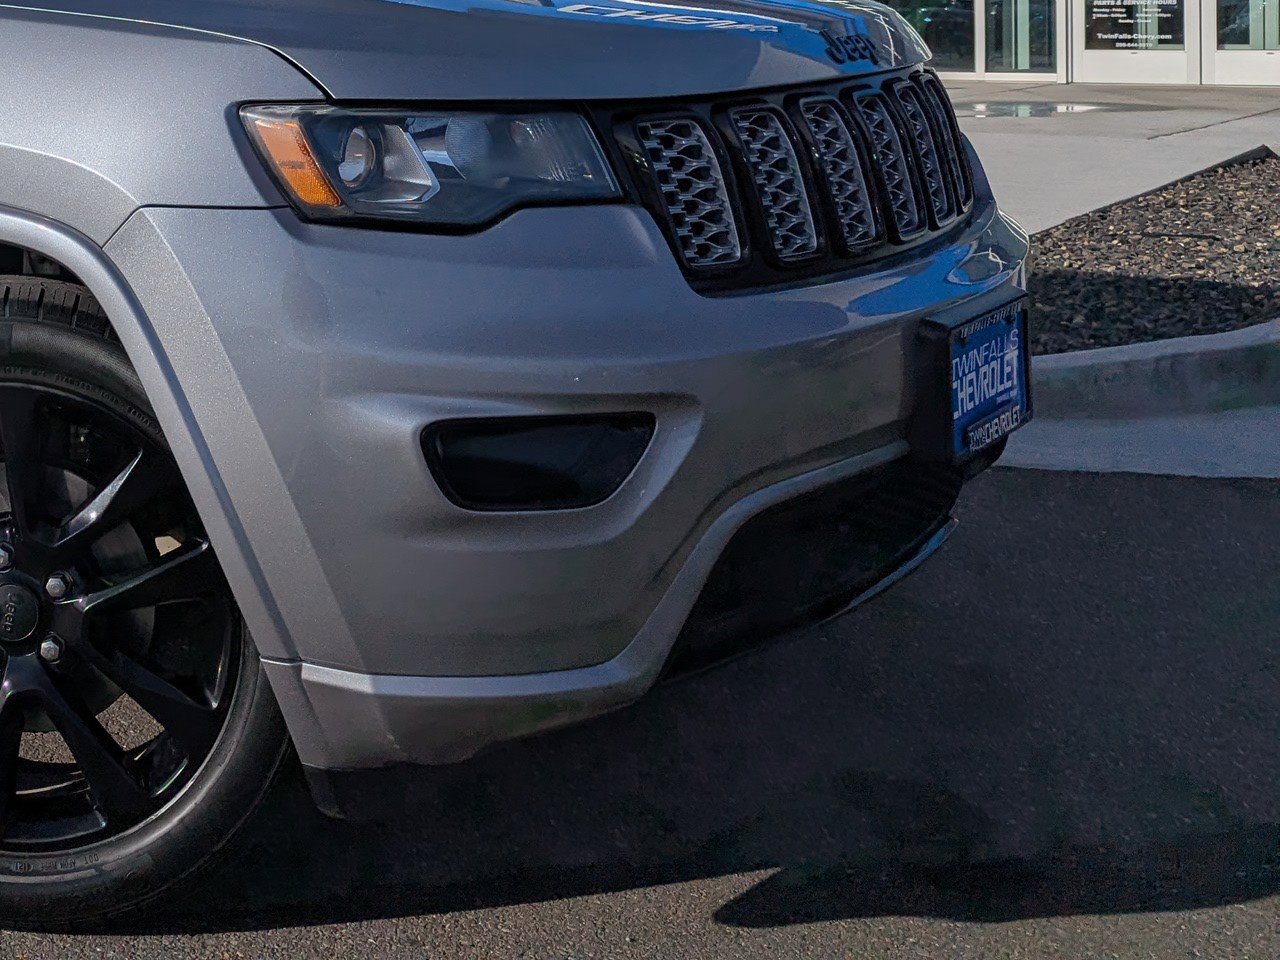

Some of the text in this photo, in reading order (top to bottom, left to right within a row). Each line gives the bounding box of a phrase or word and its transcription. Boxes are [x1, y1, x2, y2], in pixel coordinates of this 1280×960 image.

[819, 28, 880, 66] Jeep
[952, 328, 1019, 382] TWINFALLS
[985, 405, 1020, 444] CHEVROLET
